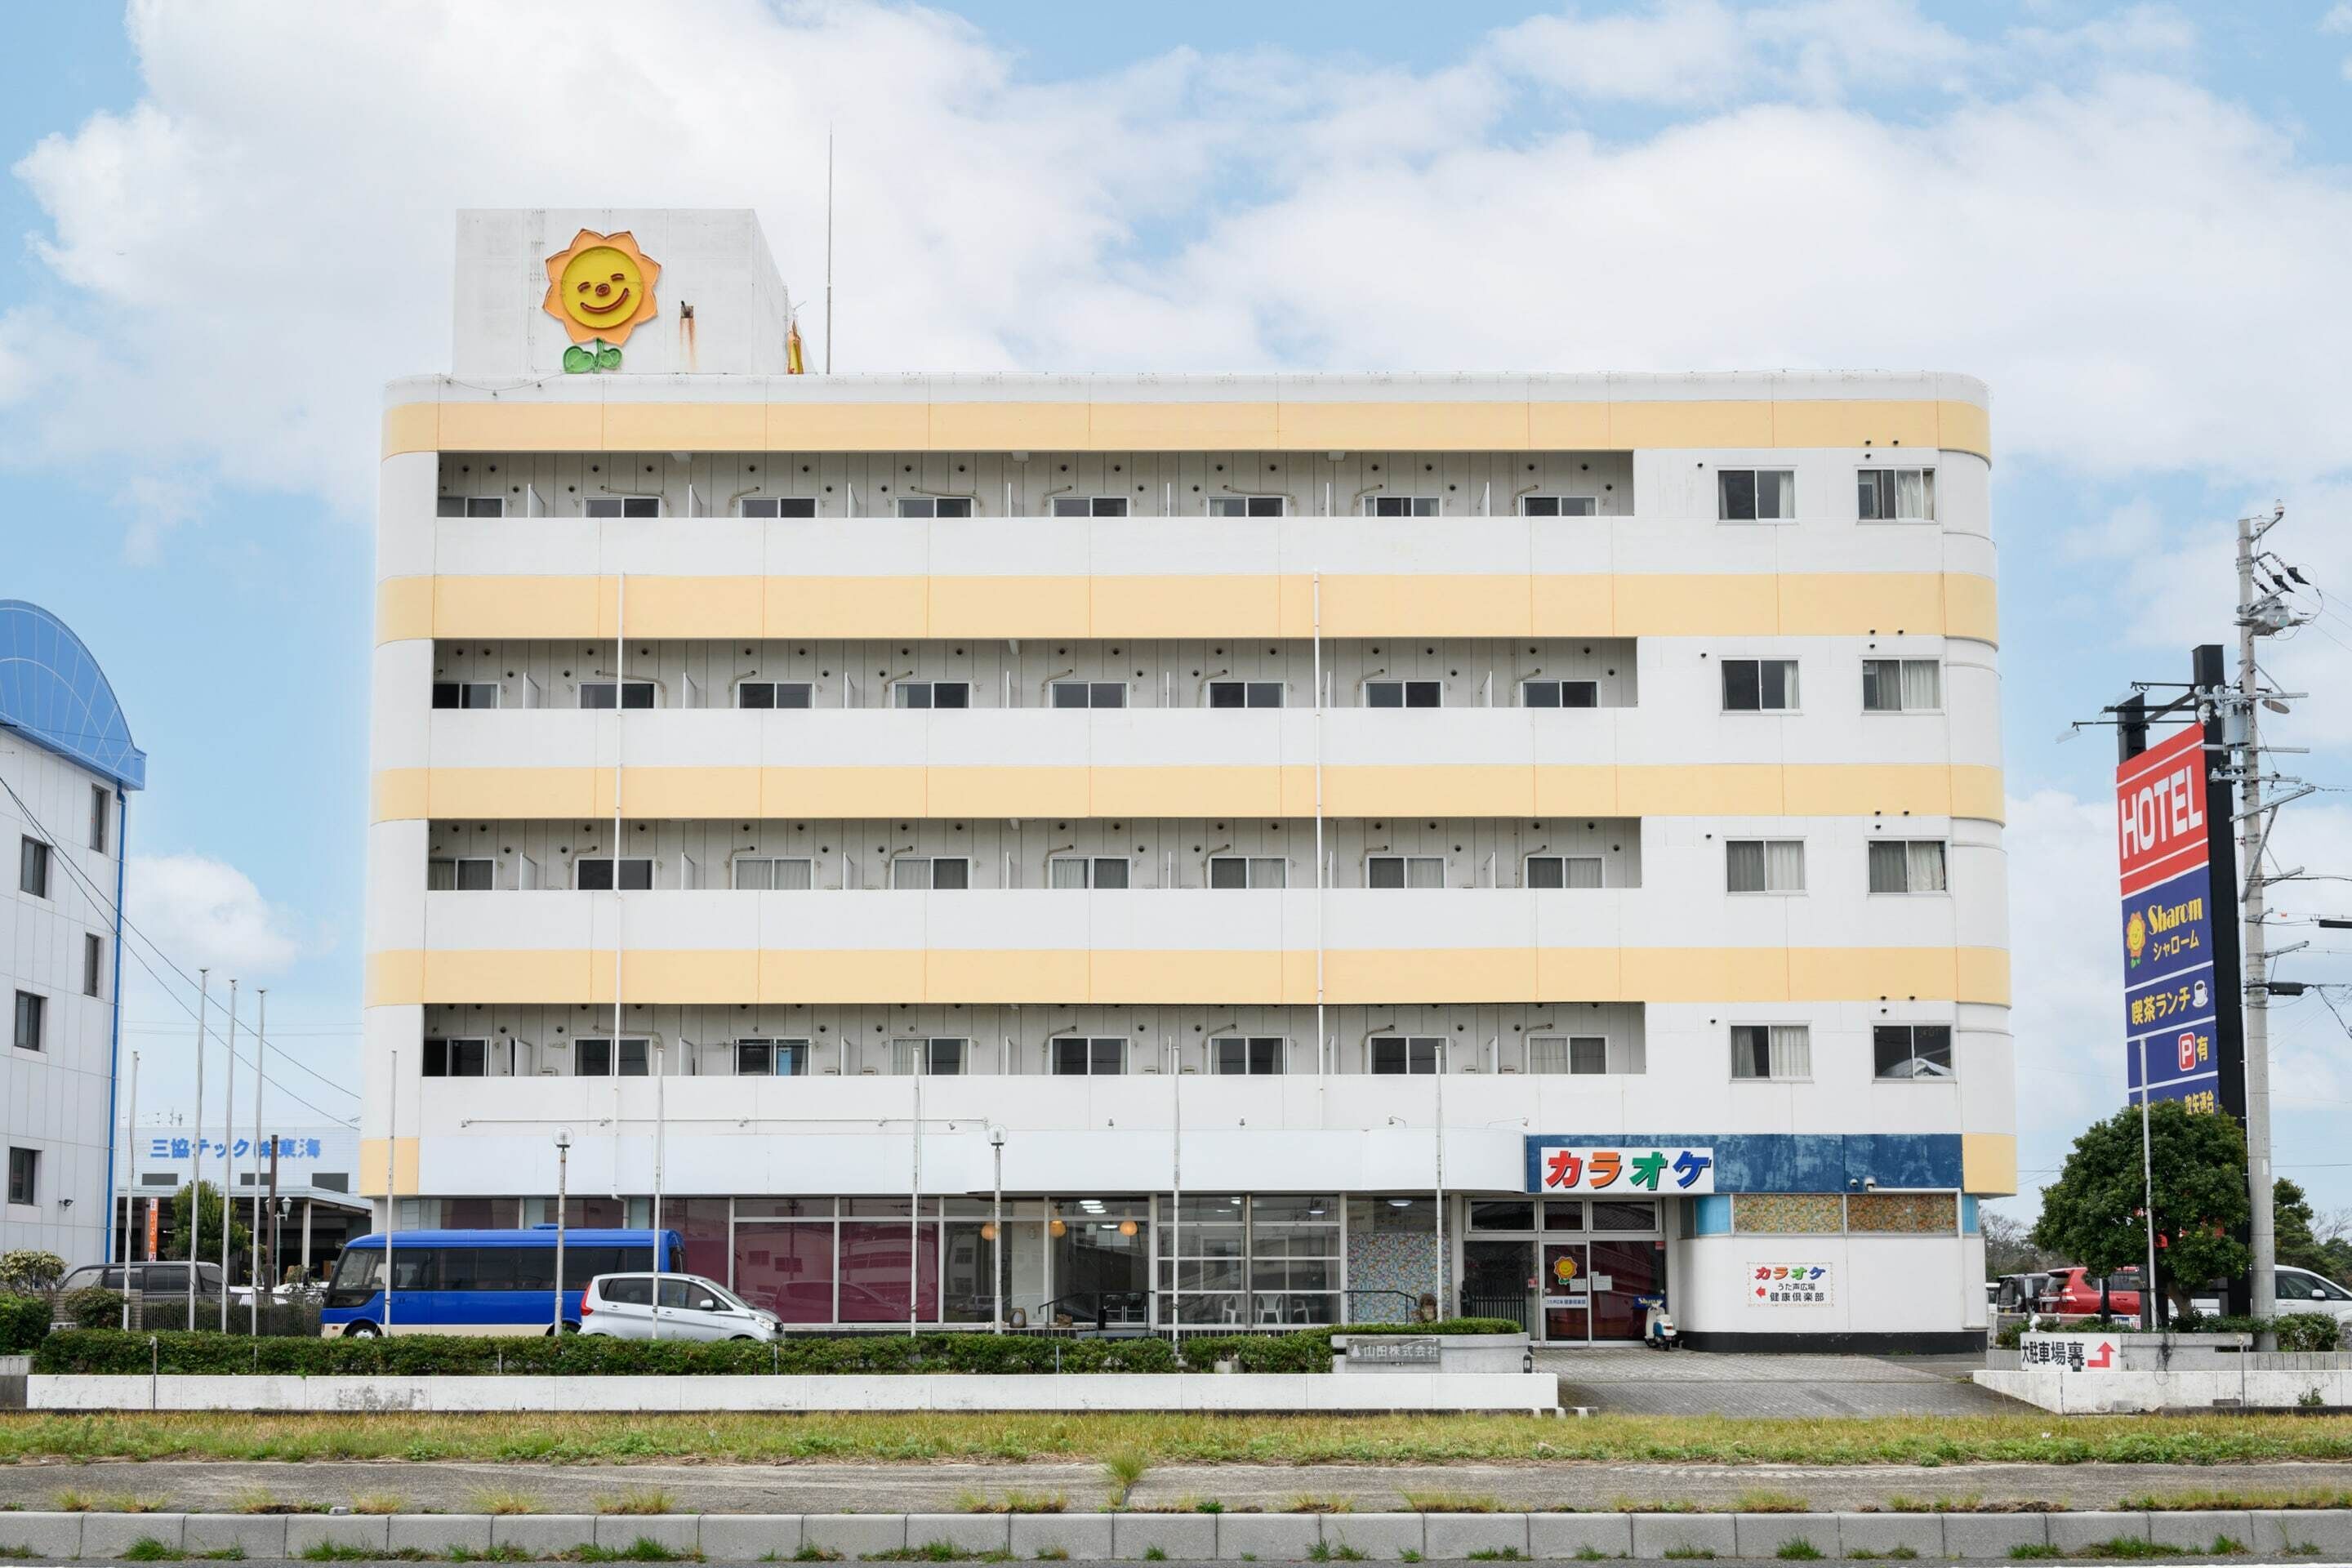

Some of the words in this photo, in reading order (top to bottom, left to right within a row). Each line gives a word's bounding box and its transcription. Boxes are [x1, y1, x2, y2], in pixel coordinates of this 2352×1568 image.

[2121, 765, 2203, 860] HOTEL
[2148, 898, 2203, 935] Sharom
[2153, 929, 2199, 961] シャローム
[2131, 986, 2190, 1026] 喫茶ランチ
[1545, 1150, 1712, 1191] カラオケ
[1754, 1266, 1826, 1281] カラオケ
[1778, 1282, 1816, 1291] うた声広場
[1770, 1292, 1824, 1302] 健康倶楽部
[1363, 1345, 1439, 1357] 山田株式会社
[2021, 1341, 2085, 1366] 大駐車場裏
